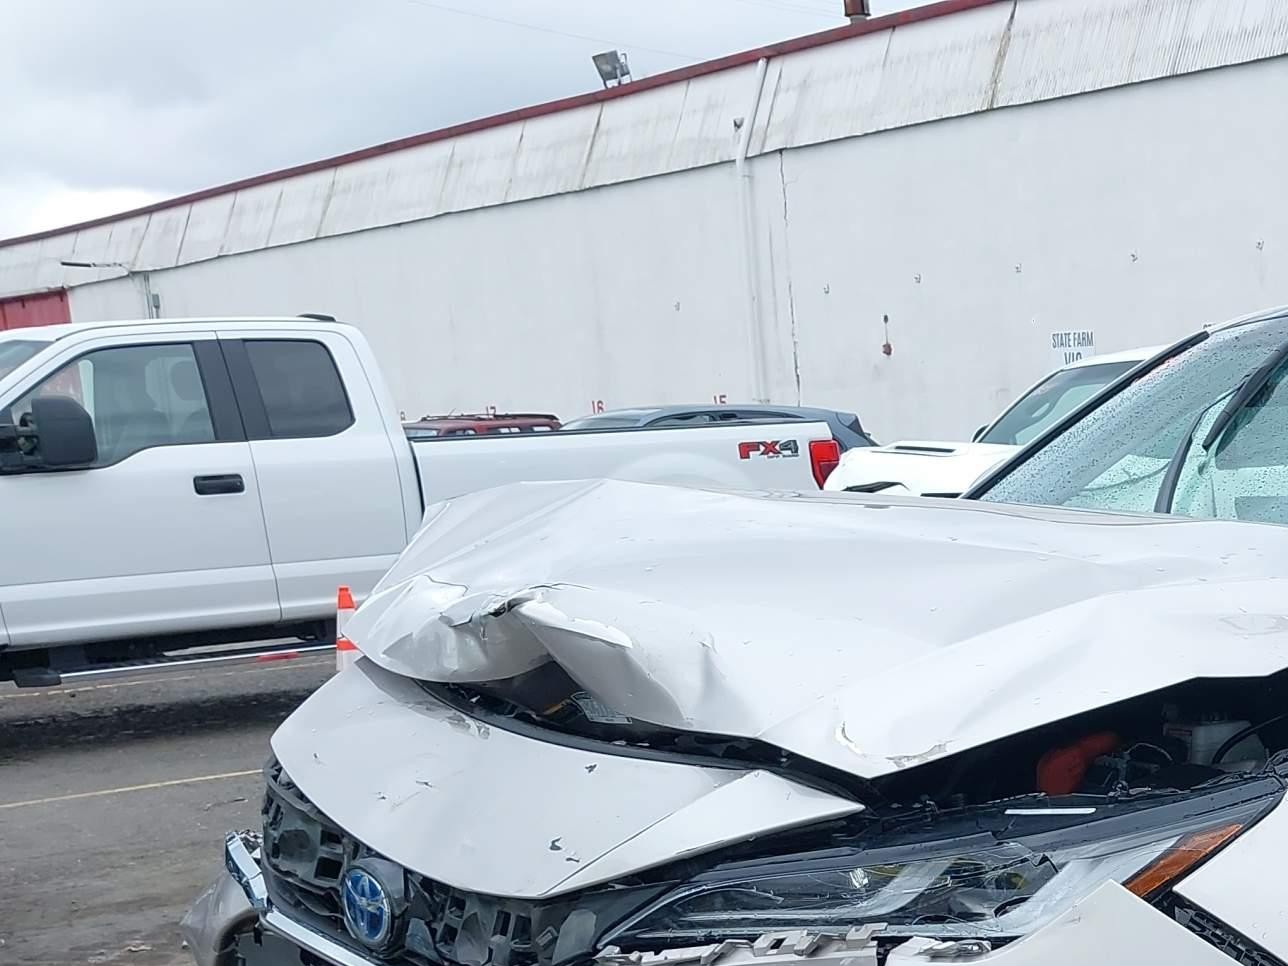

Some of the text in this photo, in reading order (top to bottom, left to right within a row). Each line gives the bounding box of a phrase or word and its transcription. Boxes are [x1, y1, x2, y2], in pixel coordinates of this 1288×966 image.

[1052, 331, 1094, 349] STATE FARM
[738, 439, 799, 460] FX4
